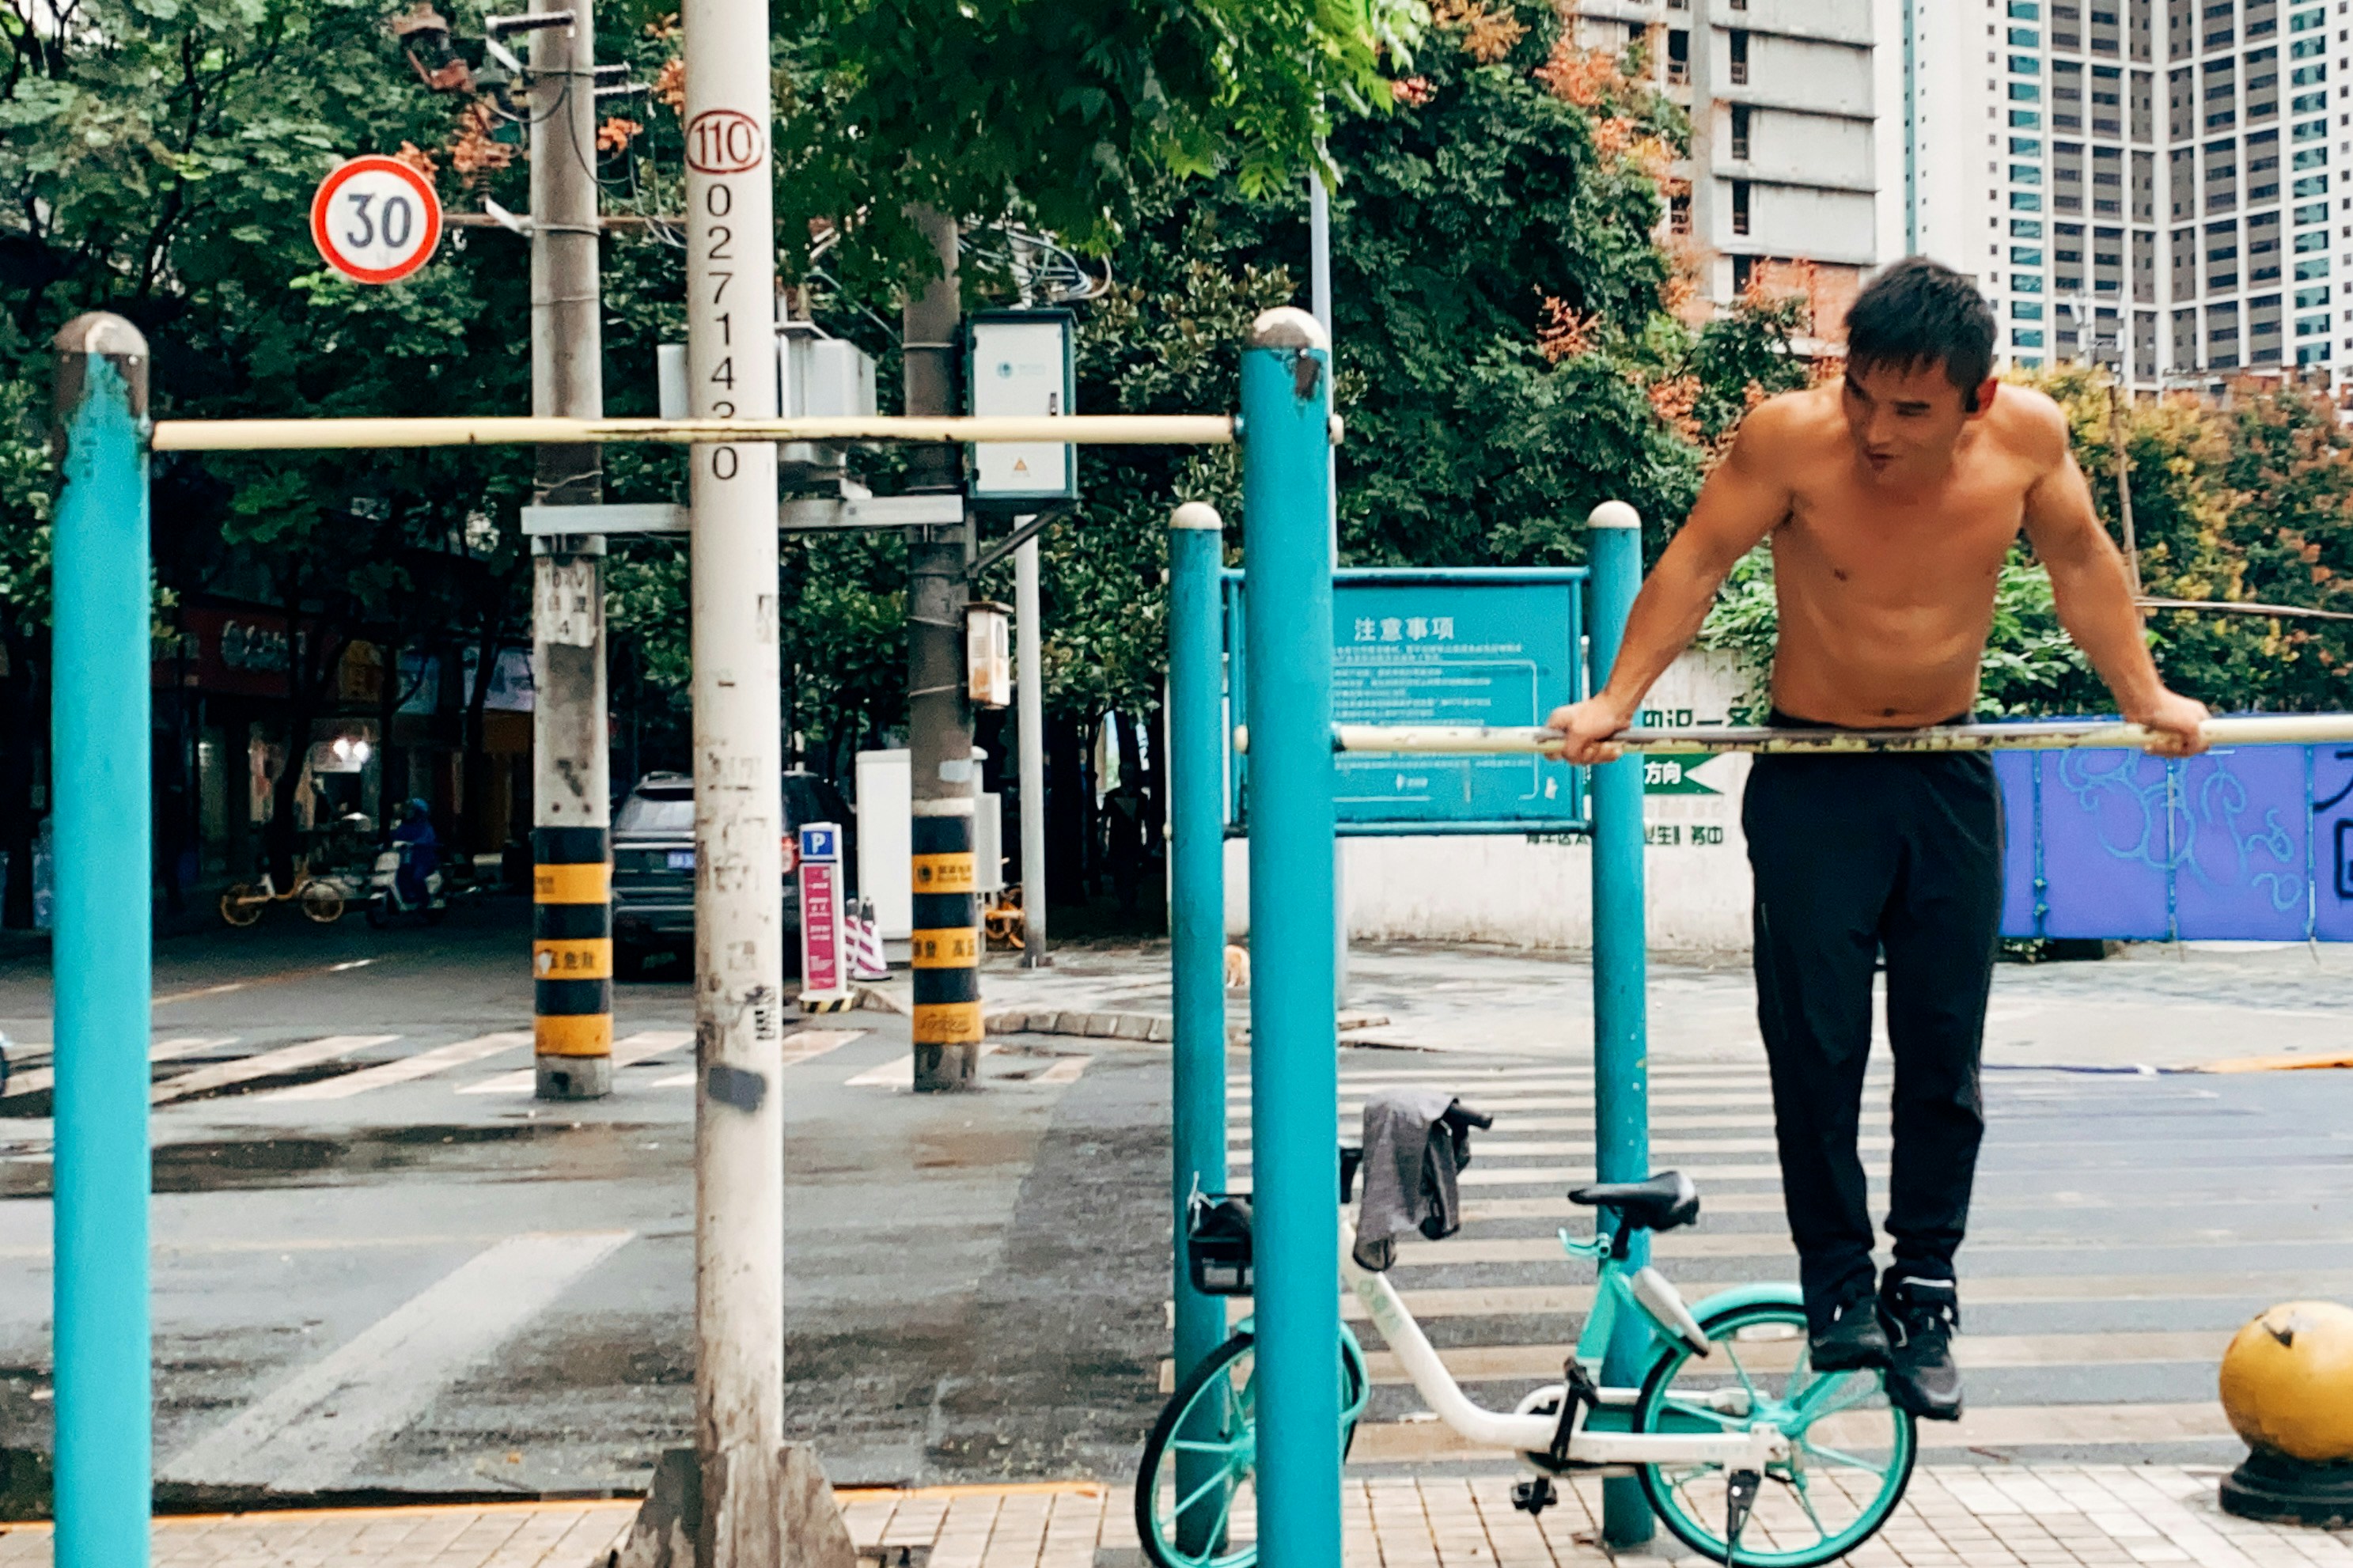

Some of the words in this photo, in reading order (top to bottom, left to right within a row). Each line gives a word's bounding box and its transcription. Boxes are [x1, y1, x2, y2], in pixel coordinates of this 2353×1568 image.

[695, 119, 752, 166] 110
[347, 194, 412, 249] 30
[1354, 616, 1455, 642] 注意事项
[1644, 760, 1682, 786] 方向
[812, 832, 826, 854] P
